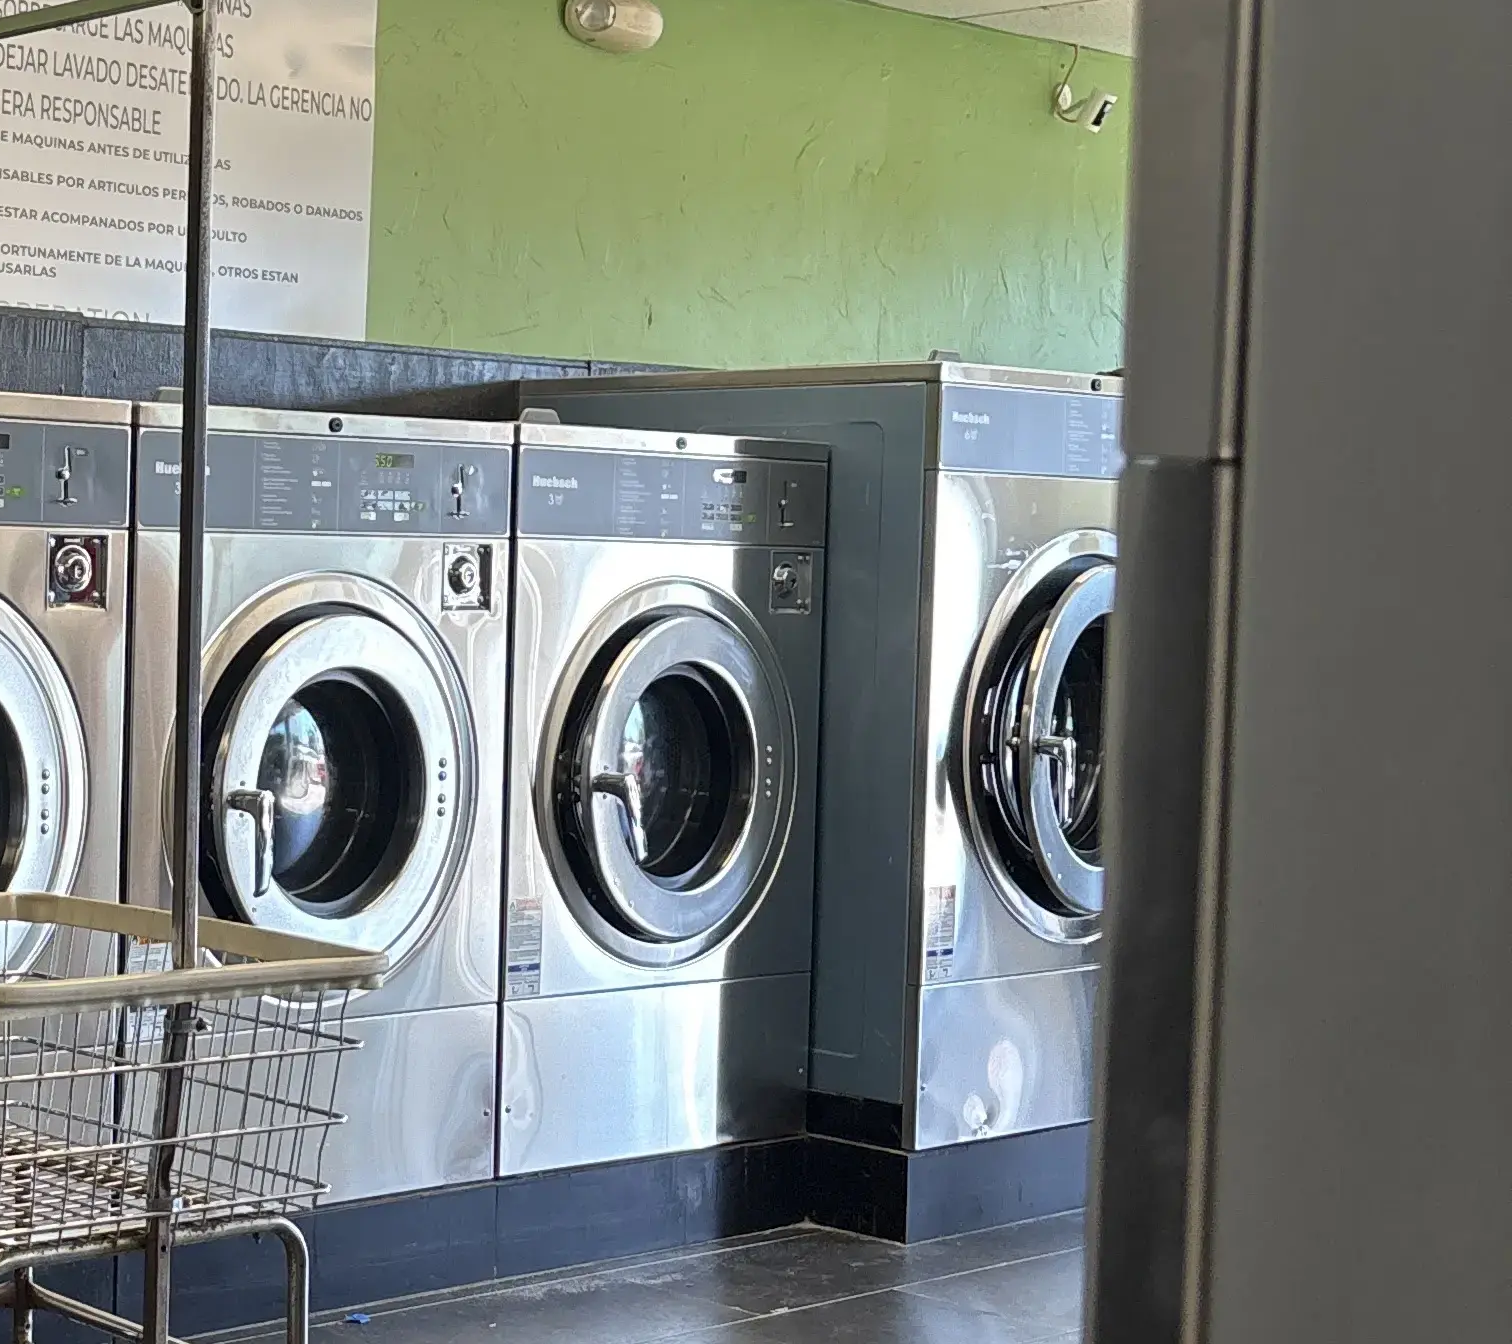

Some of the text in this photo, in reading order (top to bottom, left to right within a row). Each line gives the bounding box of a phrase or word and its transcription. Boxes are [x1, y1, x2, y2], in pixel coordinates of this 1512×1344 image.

[113, 17, 144, 45] LAS
[147, 20, 234, 59] MAQAS
[52, 50, 122, 86] LAVADO
[125, 61, 244, 104] DESATEDO.
[247, 80, 267, 108] LA
[269, 84, 347, 119] GERENCIA
[349, 95, 373, 122] NO
[40, 93, 162, 136] RESPONSABLE
[11, 131, 85, 152] MAQUINAS
[86, 141, 130, 158] ANTES
[132, 147, 151, 161] DE
[153, 149, 232, 171] UTILIZAS
[56, 174, 85, 190] POR
[87, 178, 160, 198] ARTICULOS
[231, 195, 292, 214] ROBADOS
[293, 203, 303, 215] O
[305, 204, 364, 222] DANADOS
[40, 210, 145, 233] ACOMPANADOS
[147, 221, 175, 236] POR
[104, 253, 123, 267] DE
[125, 255, 142, 269] LA
[217, 266, 259, 280] OTROS
[261, 269, 299, 284] ESTAN
